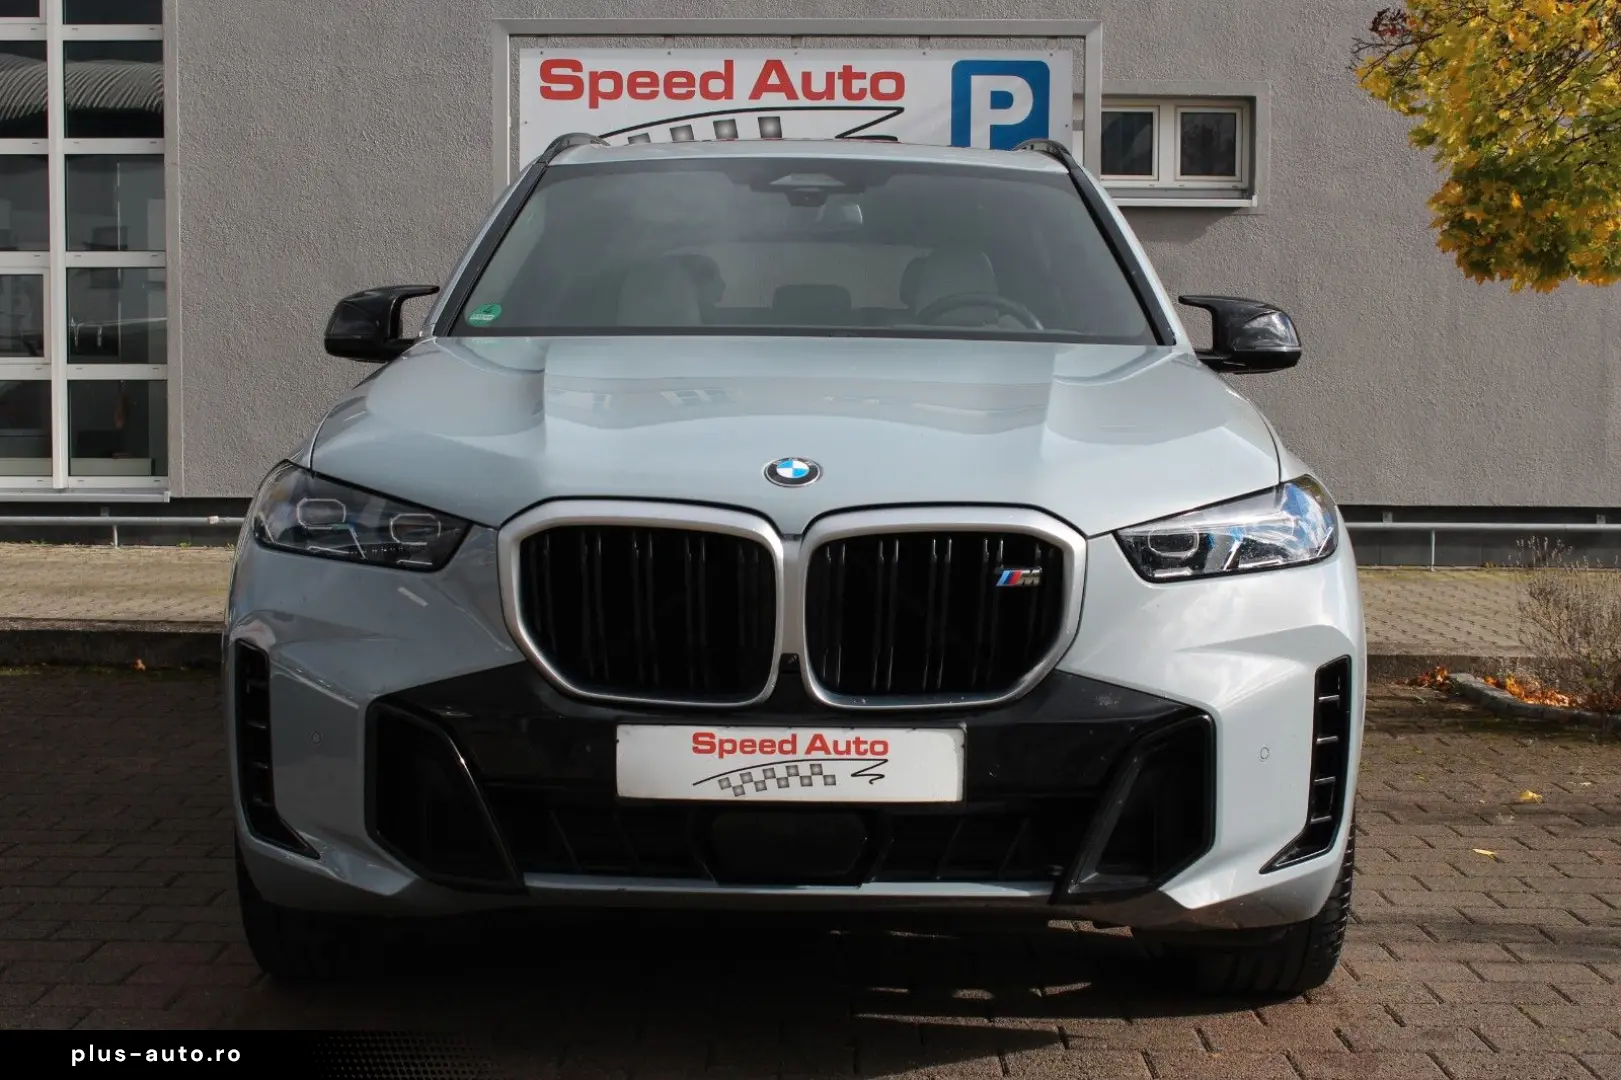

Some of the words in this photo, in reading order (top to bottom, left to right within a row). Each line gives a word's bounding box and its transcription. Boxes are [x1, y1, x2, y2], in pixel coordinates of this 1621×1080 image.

[539, 58, 735, 109] Speed
[748, 59, 906, 102] Auto
[970, 75, 1034, 150] P
[691, 731, 798, 759] Speed
[804, 732, 890, 757] Auto
